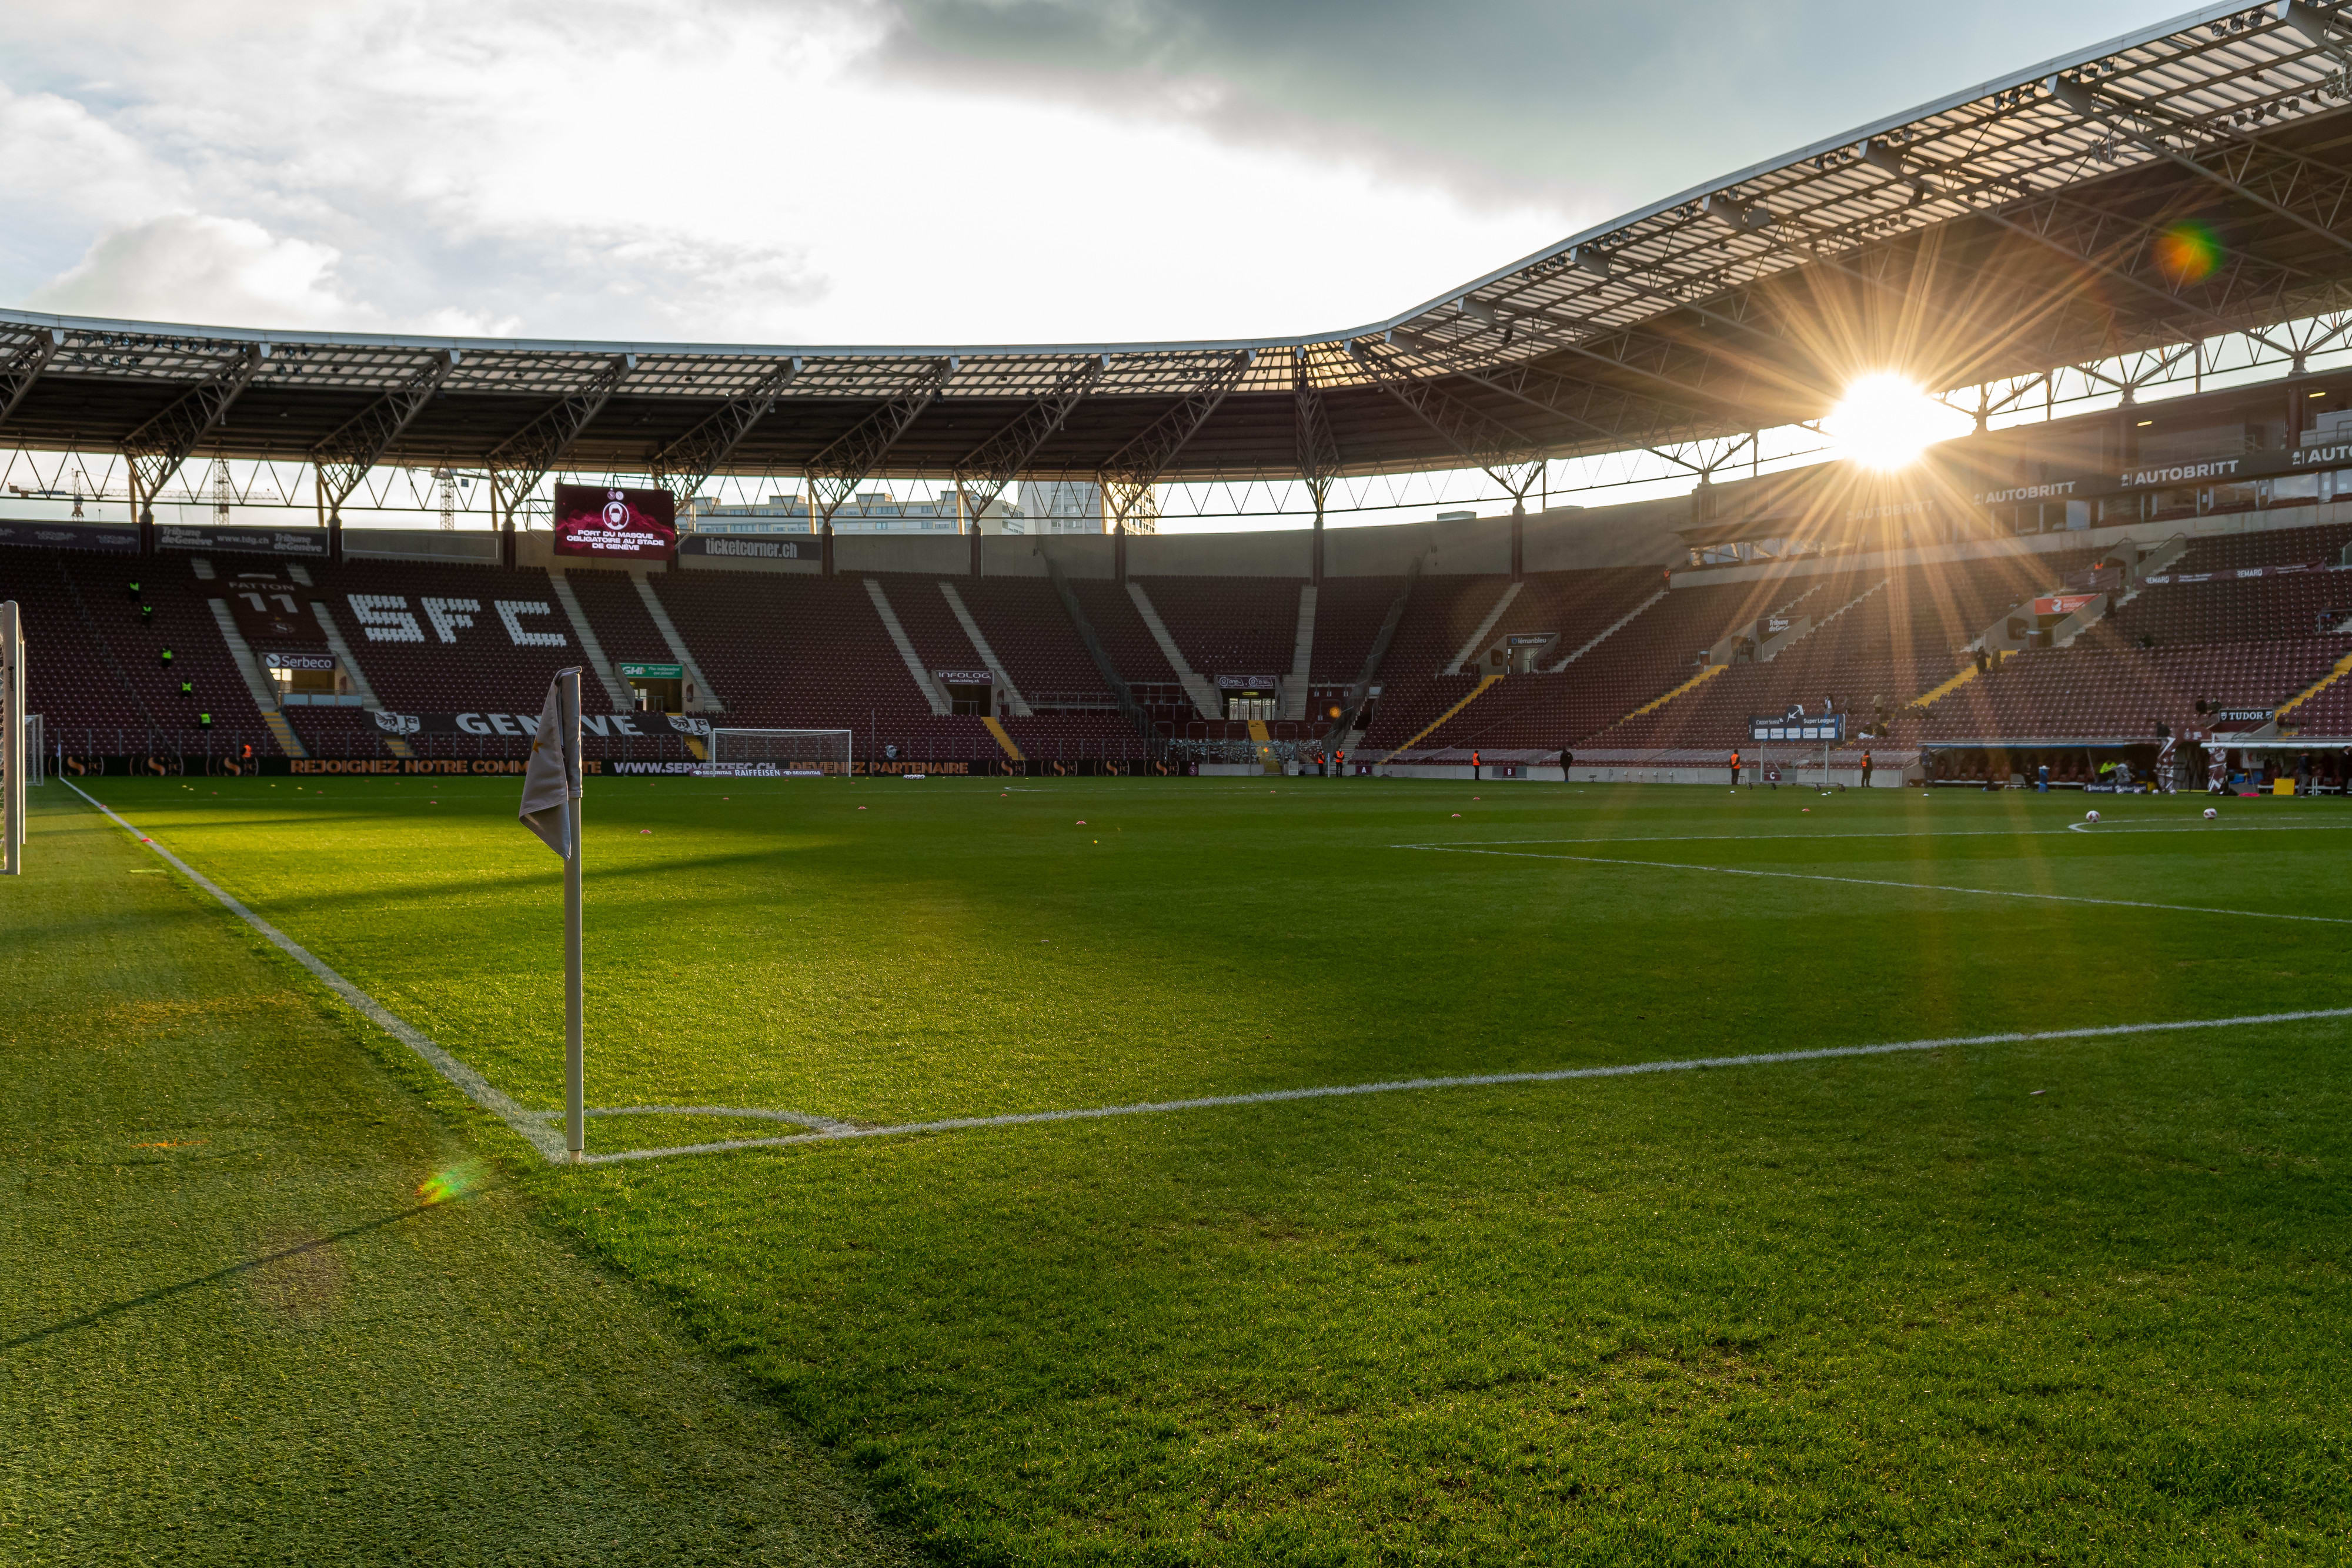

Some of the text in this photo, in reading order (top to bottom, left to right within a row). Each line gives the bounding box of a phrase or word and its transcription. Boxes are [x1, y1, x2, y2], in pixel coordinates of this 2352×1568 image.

[2307, 445, 2352, 463] AUT
[2134, 459, 2239, 485] AUTOBRITT
[1984, 480, 2076, 503] AUTOBRITT
[162, 526, 202, 537] Tribune
[617, 531, 653, 539] MASQUE
[216, 535, 269, 545] www.tdg.ch
[275, 533, 312, 544] Tribune
[566, 535, 621, 543] OBLIGATOIRE
[606, 543, 640, 551] GENÈVE
[705, 537, 797, 559] ticketcorner.ch
[238, 593, 299, 613] 11
[347, 594, 568, 648] SFC
[282, 656, 332, 669] Serbeco
[2229, 711, 2263, 720] TUDOR
[456, 713, 644, 736] GENVE
[290, 760, 399, 774] REJOIGNEZ
[405, 760, 467, 774] NOTRE
[871, 761, 968, 774] PARTENAIRE
[1769, 771, 1775, 780] C
